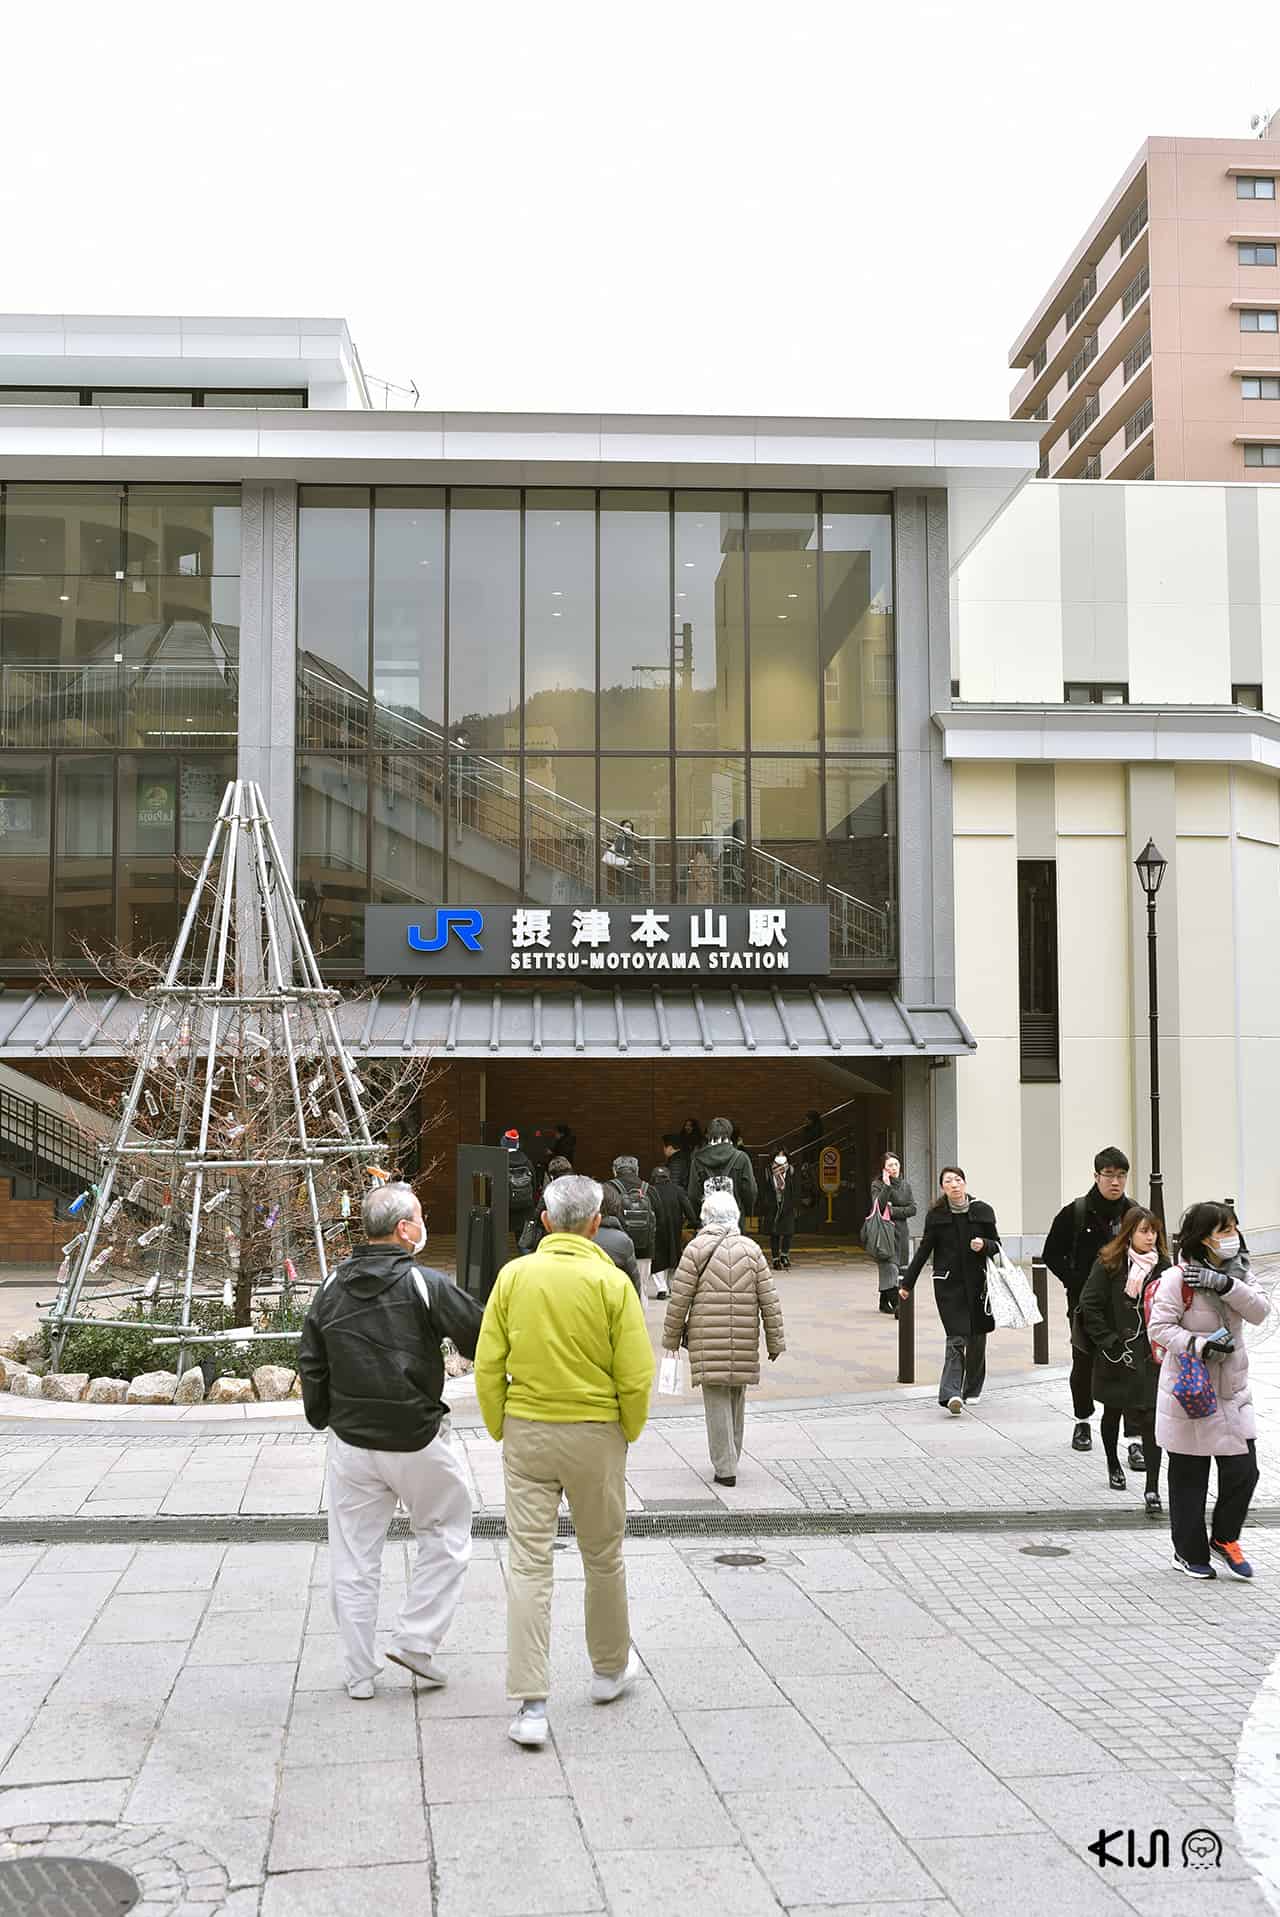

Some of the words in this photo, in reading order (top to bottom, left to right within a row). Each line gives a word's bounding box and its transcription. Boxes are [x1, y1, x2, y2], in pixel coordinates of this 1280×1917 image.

[408, 909, 484, 951] JR
[512, 909, 787, 948] 摂津本山駅
[511, 952, 700, 969] SETTSU-MOTOYAMA
[709, 952, 789, 969] STATION
